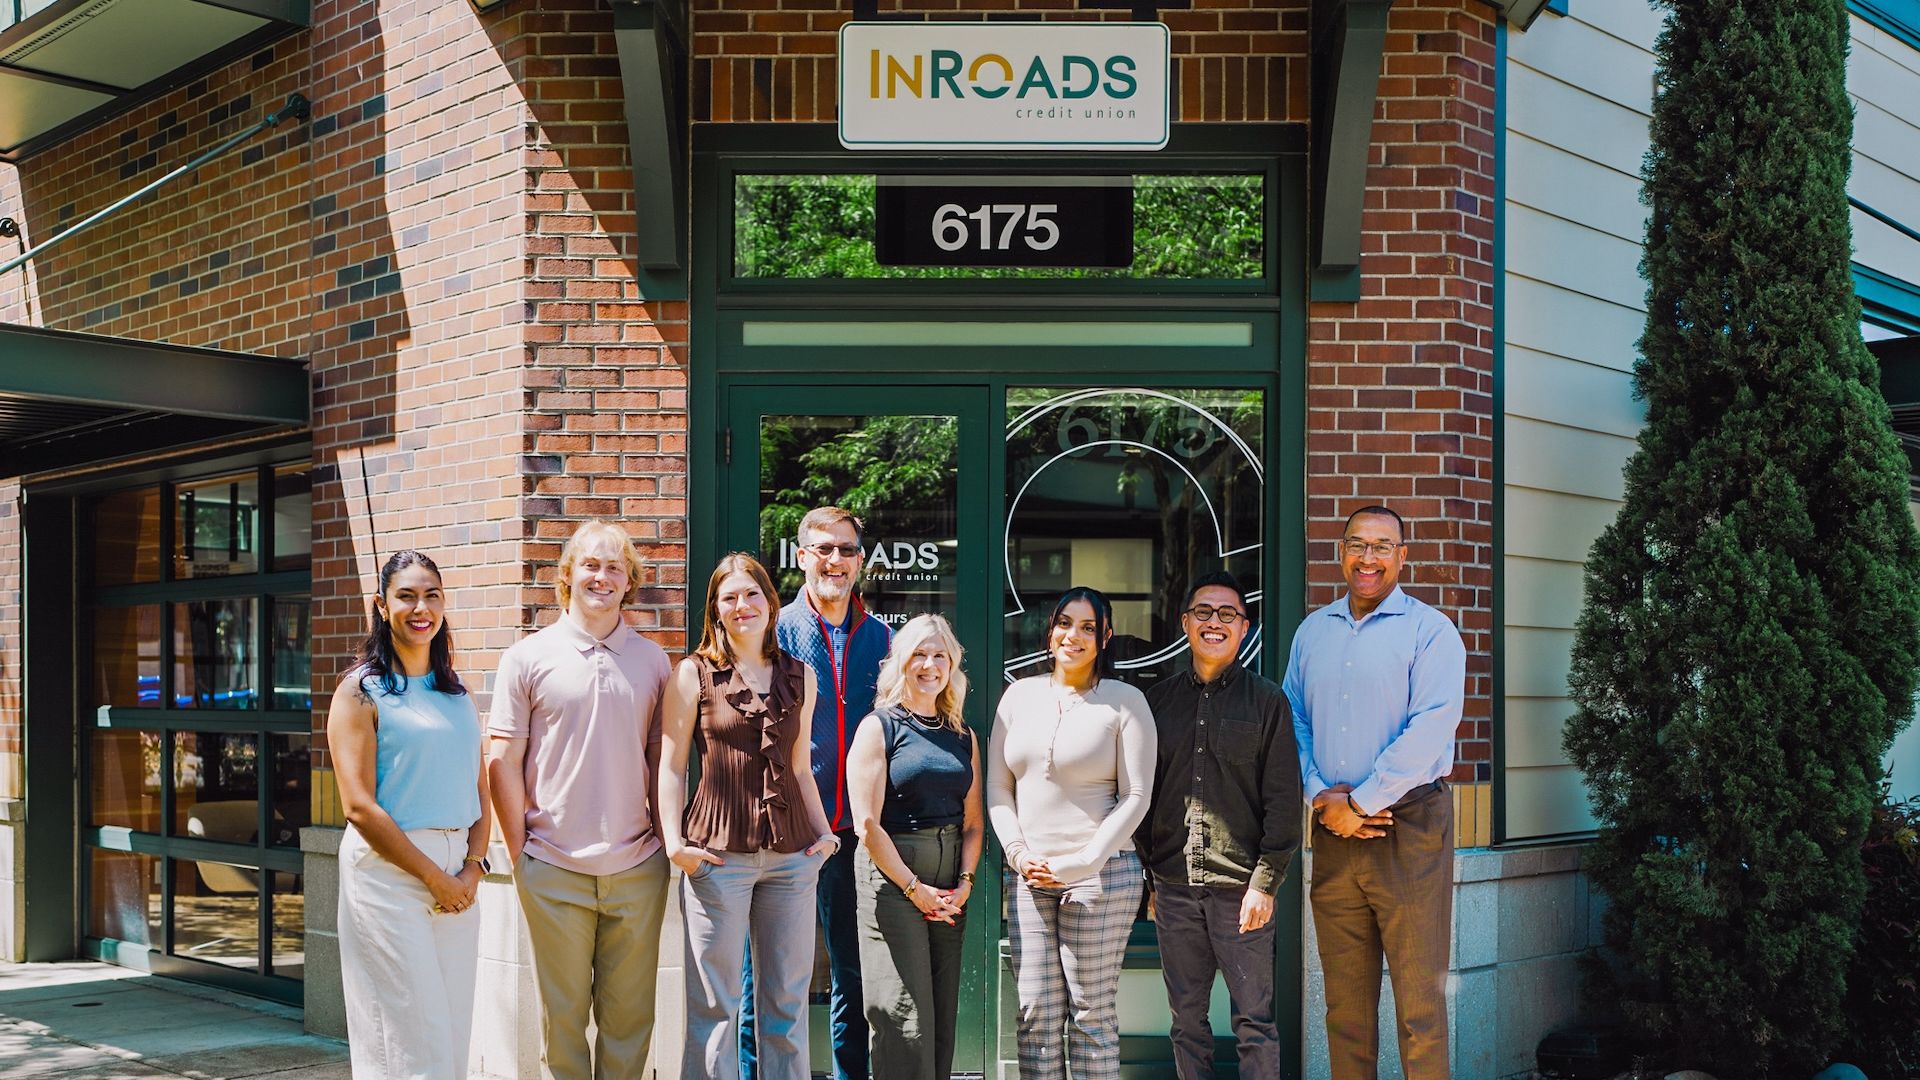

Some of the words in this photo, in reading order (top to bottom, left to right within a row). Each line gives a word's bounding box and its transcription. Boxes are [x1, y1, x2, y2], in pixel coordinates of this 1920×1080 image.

[870, 49, 1138, 100] INROADS
[1016, 106, 1073, 119] credit
[1085, 106, 1136, 119] union
[932, 203, 1060, 251] 6175
[779, 538, 939, 570] IADS
[866, 572, 901, 581] credit
[907, 572, 938, 581] union
[869, 611, 908, 624] ours
